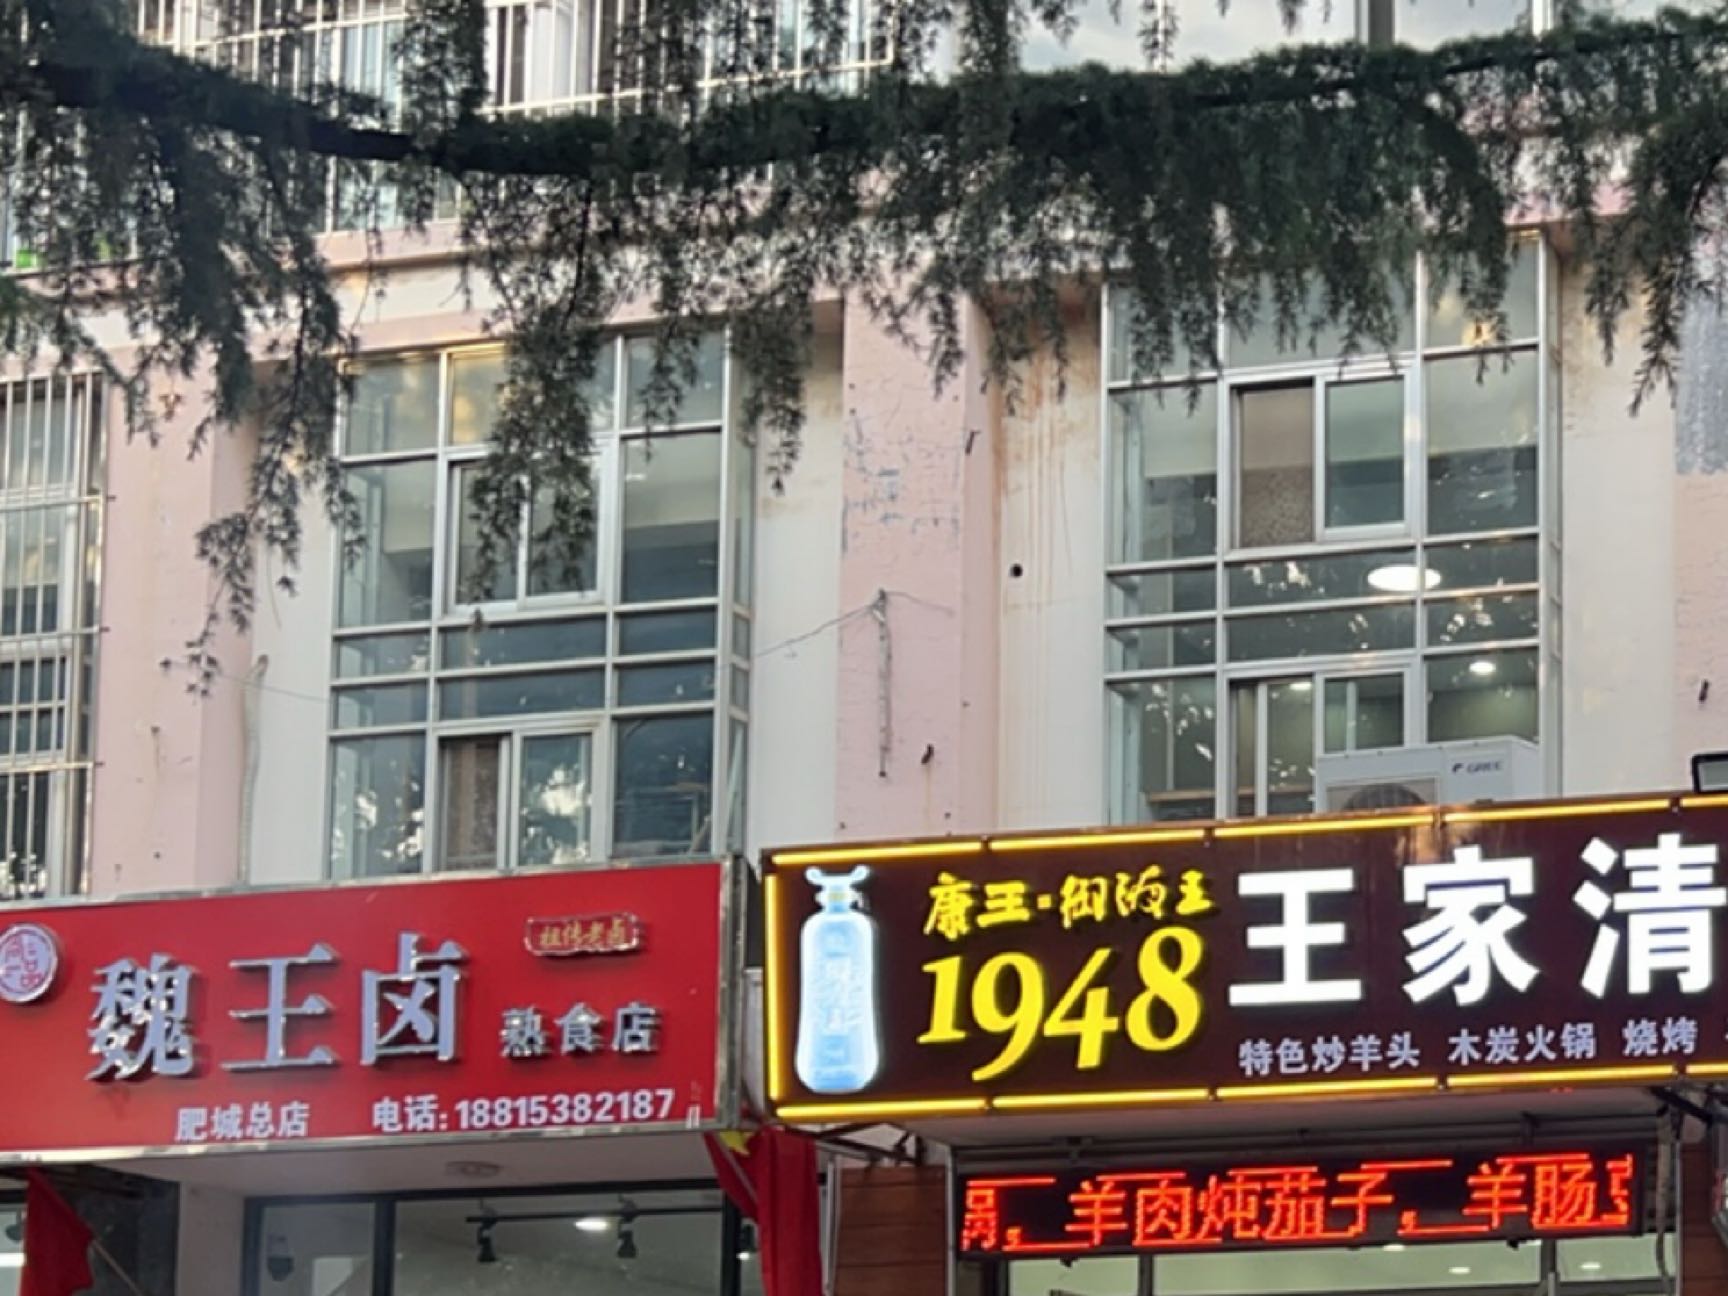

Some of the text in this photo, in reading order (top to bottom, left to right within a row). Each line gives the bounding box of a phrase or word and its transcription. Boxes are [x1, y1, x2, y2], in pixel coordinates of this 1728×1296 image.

[86, 931, 467, 1081] 魏王卤
[500, 1001, 656, 1057] 熟食店
[917, 927, 1203, 1081] 1948
[1239, 1032, 1420, 1076] 特色炒羊头
[1448, 1022, 1597, 1065] 木炭火锅
[1622, 1016, 1698, 1057] 烧烤
[175, 1102, 310, 1142] 肥城总店
